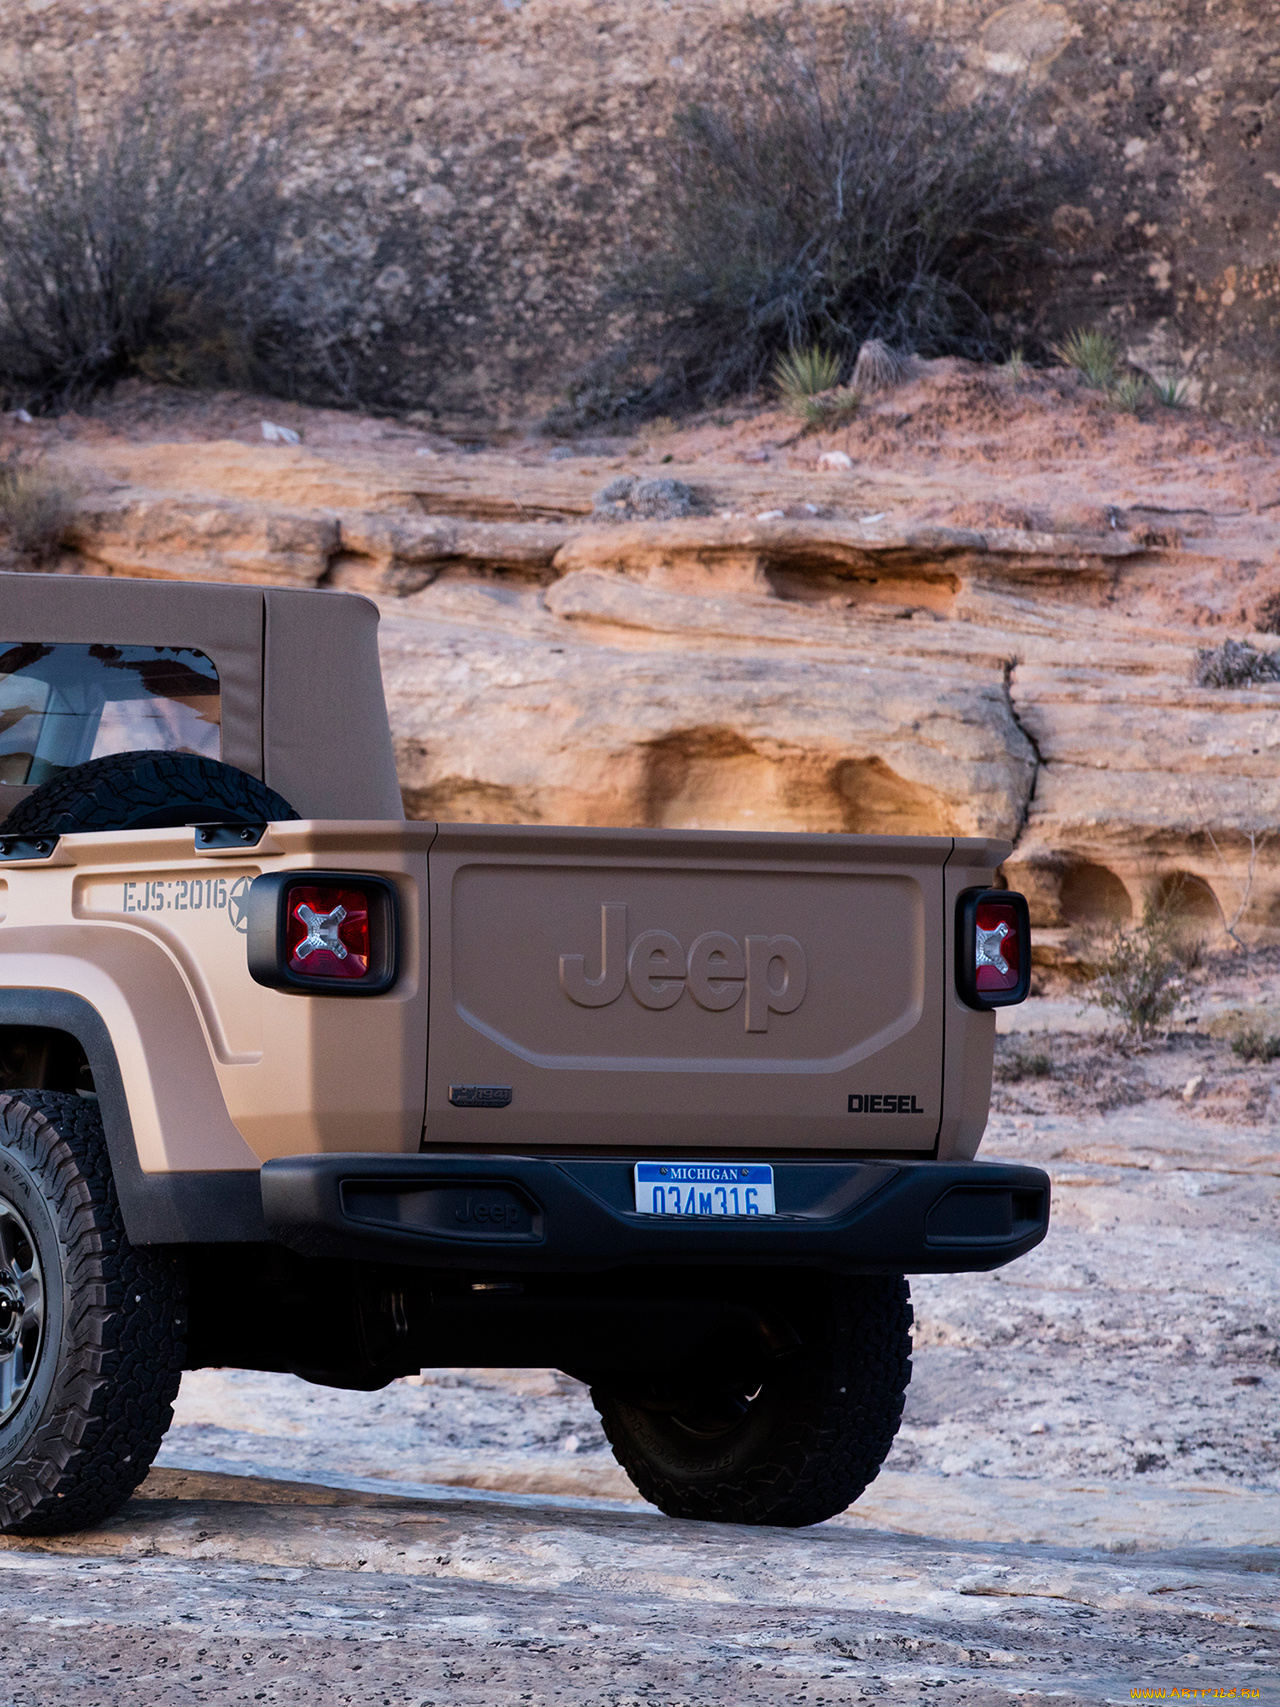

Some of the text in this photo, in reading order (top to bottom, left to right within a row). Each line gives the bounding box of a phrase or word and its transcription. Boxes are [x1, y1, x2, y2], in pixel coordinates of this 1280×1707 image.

[123, 879, 227, 912] EJS:2016
[557, 901, 809, 1034] Jeep
[847, 1094, 925, 1115] DIESEL
[670, 1167, 738, 1180] MICHIGAN
[455, 1196, 520, 1229] Jeep
